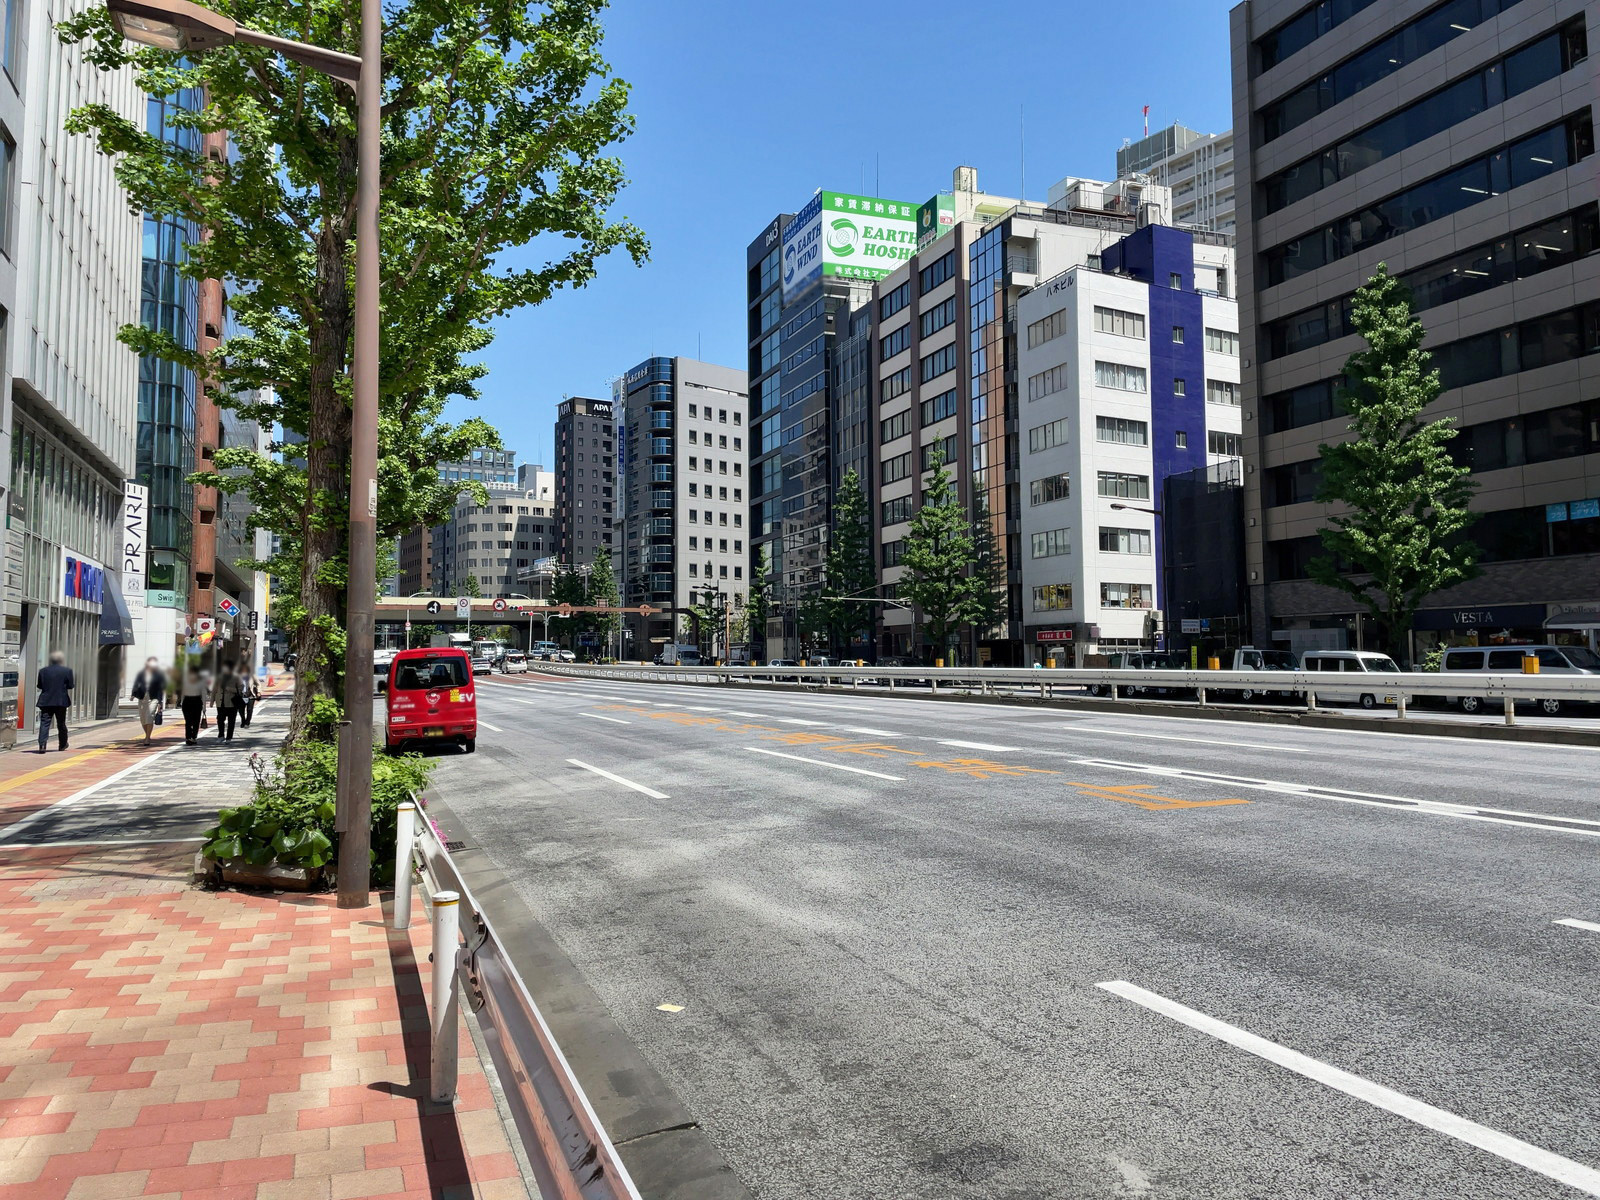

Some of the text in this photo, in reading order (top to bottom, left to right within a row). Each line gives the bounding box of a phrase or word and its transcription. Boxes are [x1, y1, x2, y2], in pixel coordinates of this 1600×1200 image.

[833, 197, 911, 217] 家賃滞納保証
[797, 222, 822, 255] EARTH
[862, 226, 917, 245] EARTH
[797, 243, 818, 271] WIND
[1046, 276, 1074, 298] 八木ビル
[593, 403, 609, 412] APA
[1453, 611, 1493, 624] VESTA
[459, 693, 474, 703] EV
